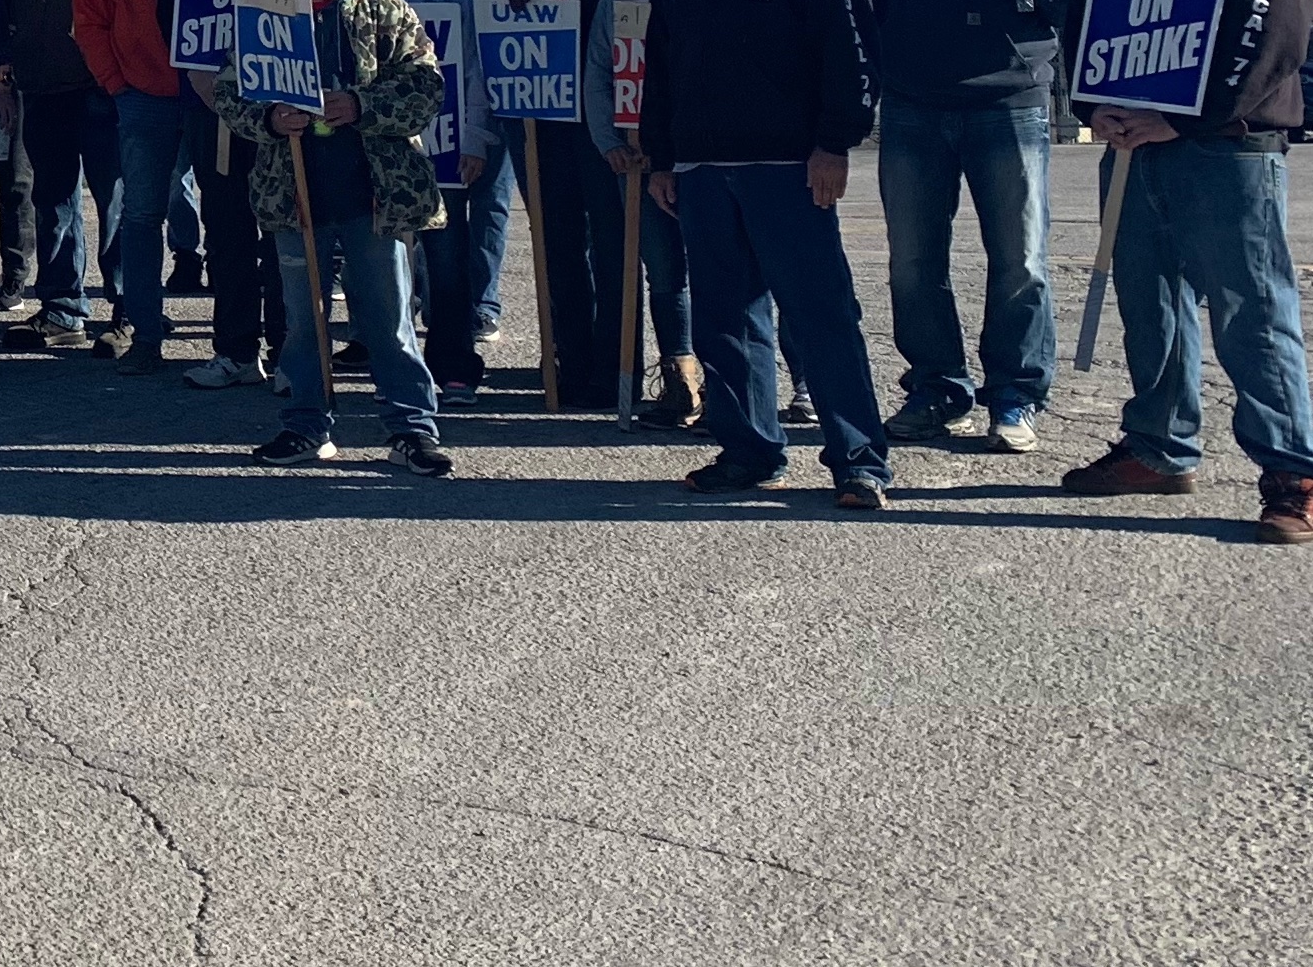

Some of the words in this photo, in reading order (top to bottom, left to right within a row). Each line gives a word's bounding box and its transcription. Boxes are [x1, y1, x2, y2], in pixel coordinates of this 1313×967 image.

[181, 12, 233, 56] STR
[257, 13, 293, 52] ON
[499, 35, 548, 70] ON
[1085, 23, 1205, 85] STRIKE
[1225, 56, 1250, 87] 74
[242, 54, 318, 97] STRIKE
[487, 74, 573, 111] STRIKE
